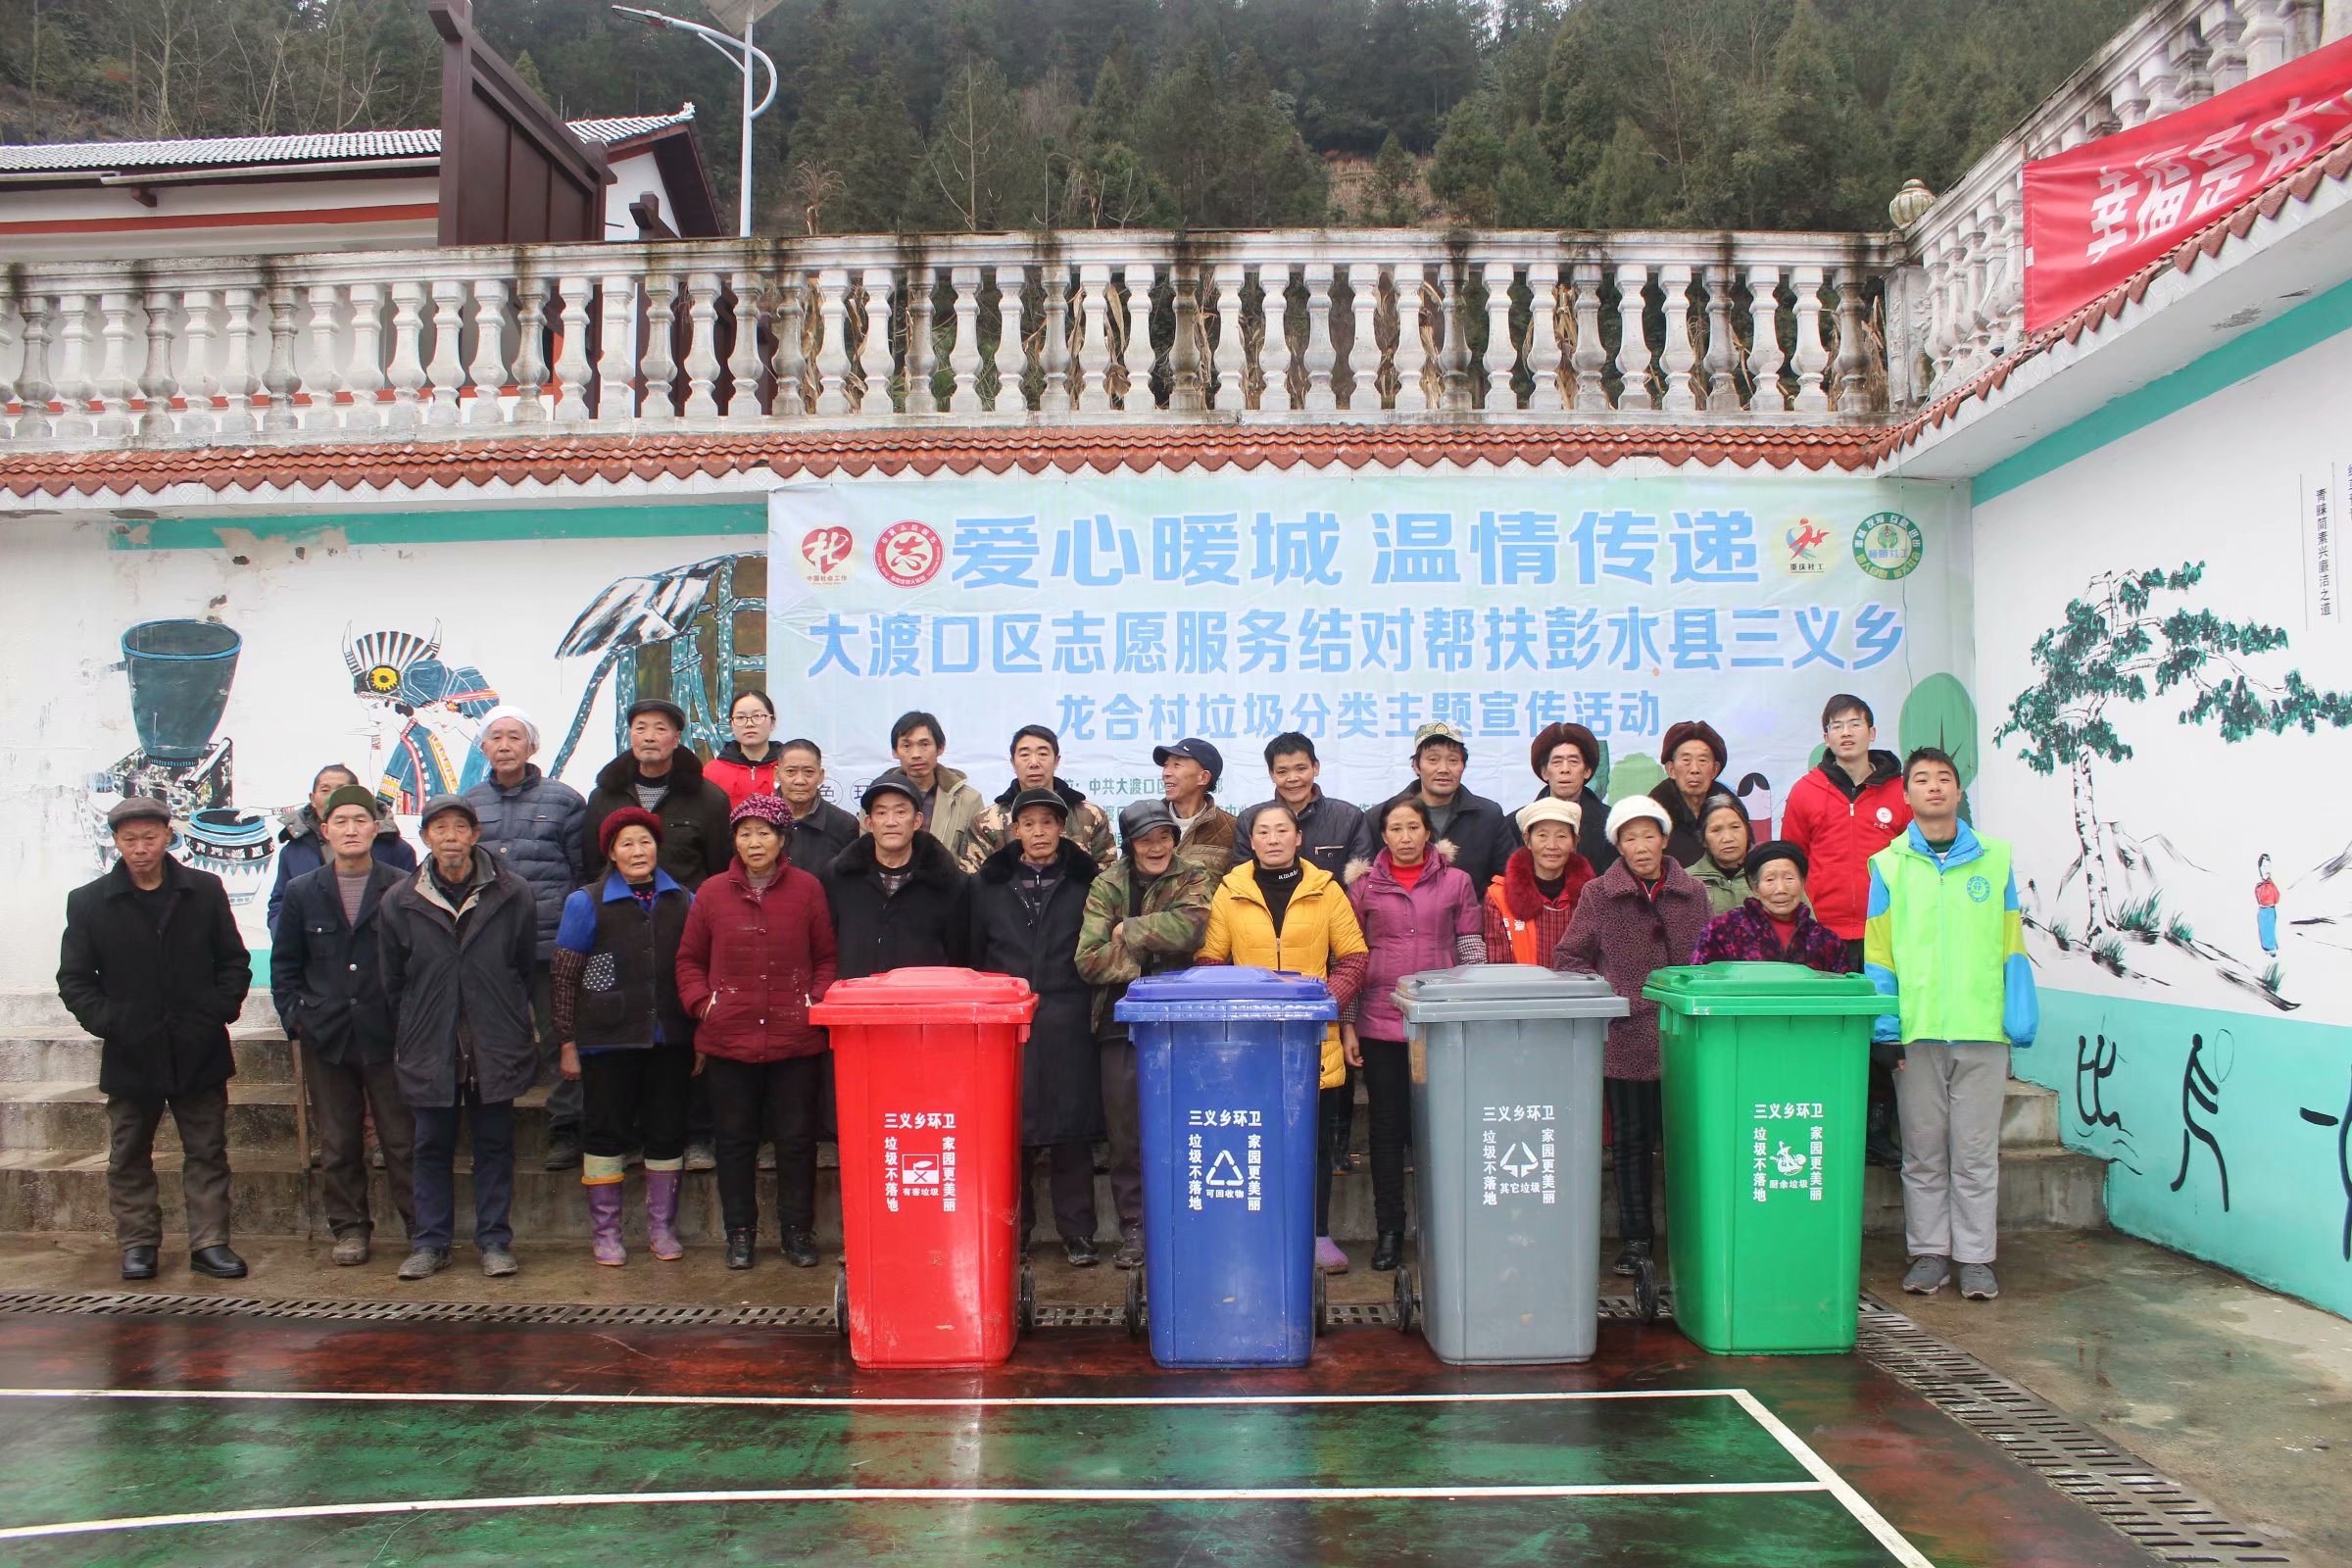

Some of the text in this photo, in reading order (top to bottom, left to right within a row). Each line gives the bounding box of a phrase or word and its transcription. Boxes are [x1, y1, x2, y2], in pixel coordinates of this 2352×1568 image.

[952, 510, 1759, 588] 爱心暖城 温情传递
[1789, 563, 1824, 571] 重庆社工
[808, 605, 1903, 678] 大渡口区志愿服务结对帮扶彭水县三义乡
[1056, 690, 1659, 741] 龙合村垃圾分类主题宣传活动
[884, 1112, 956, 1129] 三义乡环卫
[1188, 1109, 1262, 1127] 三义乡环卫
[1482, 1104, 1555, 1122] 三义乡环卫
[1753, 1102, 1824, 1119] 三义乡环卫
[884, 1137, 899, 1212] 垃圾不落地
[903, 1187, 939, 1197] 有害垃圾
[943, 1137, 956, 1212] 家园更美丽
[1188, 1134, 1202, 1211] 垃圾不落地
[1205, 1189, 1245, 1199] 可回收物
[1248, 1134, 1262, 1211] 家园更美丽
[1483, 1130, 1497, 1205] 垃圾不落地
[1499, 1182, 1541, 1194] 其它垃圾
[1542, 1128, 1555, 1204] 家园更美丽
[1753, 1127, 1767, 1202] 垃圾不落地
[1809, 1126, 1823, 1200] 家园更美丽
